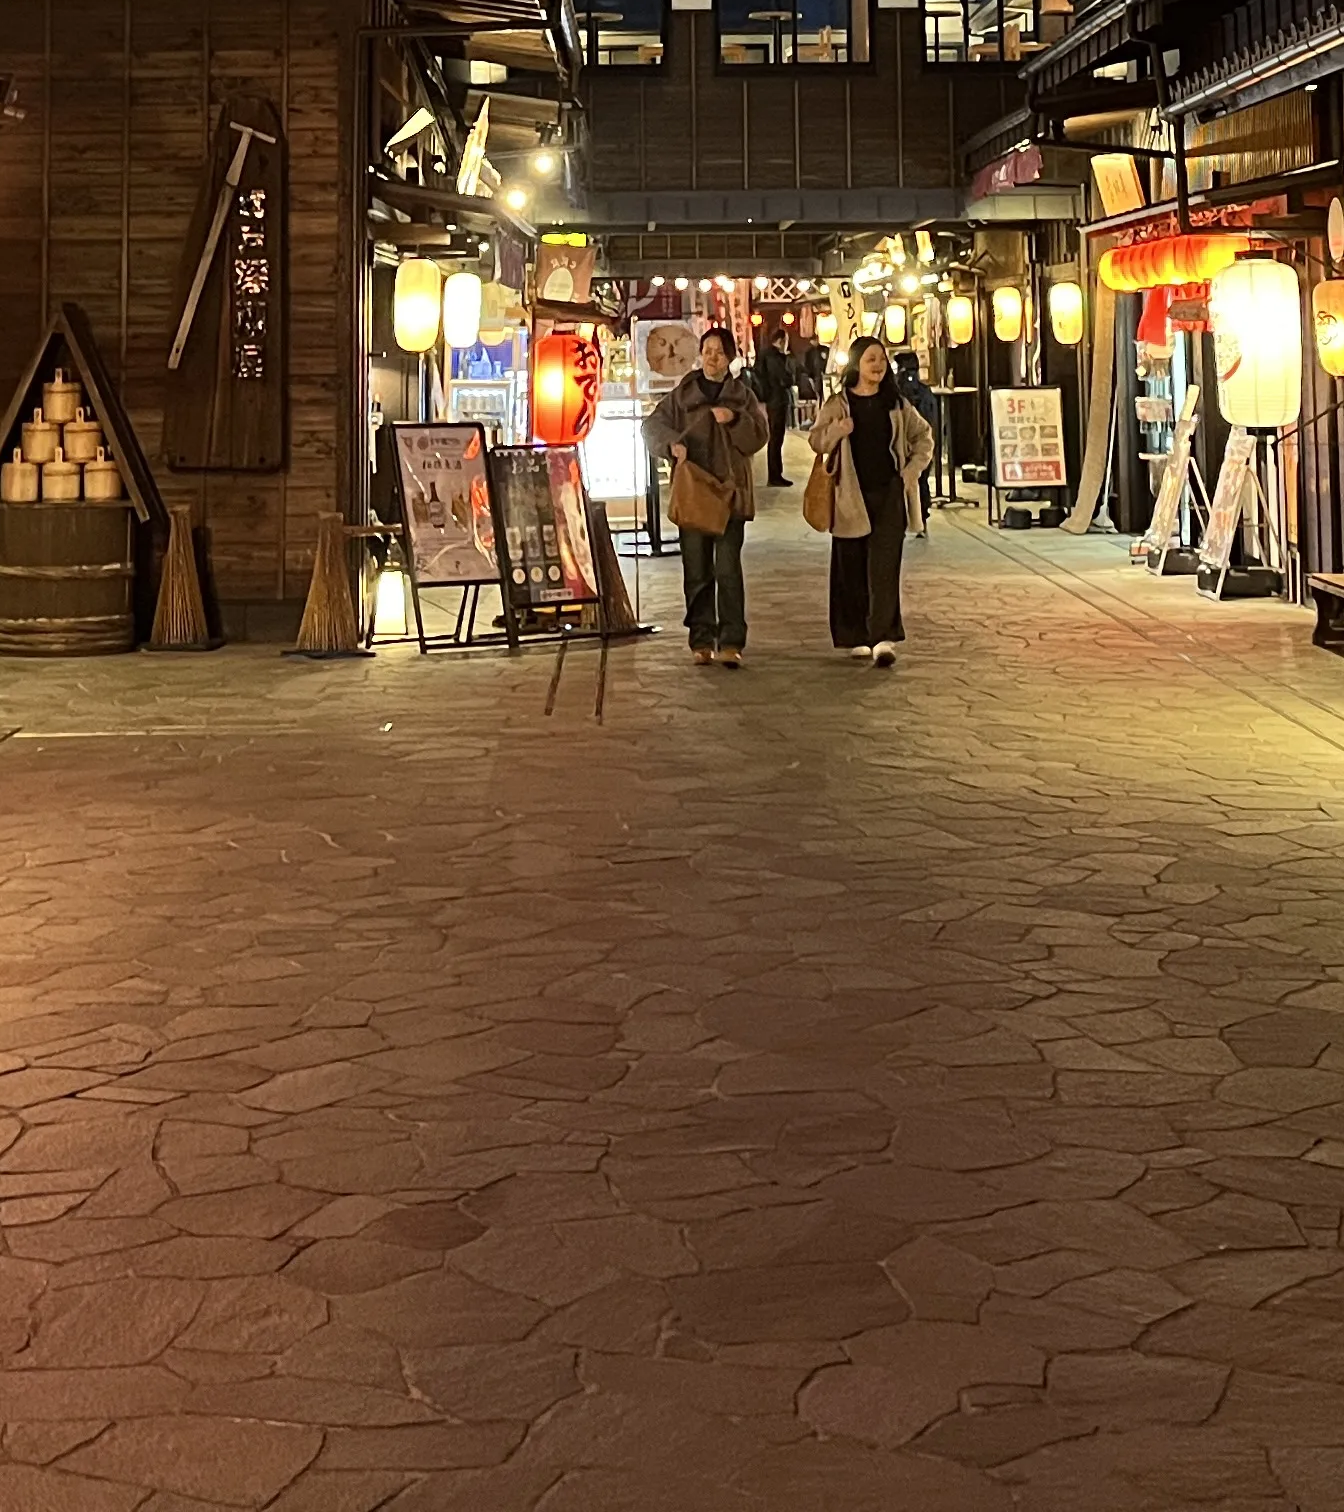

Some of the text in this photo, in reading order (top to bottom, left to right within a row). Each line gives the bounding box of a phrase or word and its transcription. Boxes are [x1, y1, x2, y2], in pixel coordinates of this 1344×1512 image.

[571, 339, 601, 436] おでん
[1007, 398, 1026, 414] 3F
